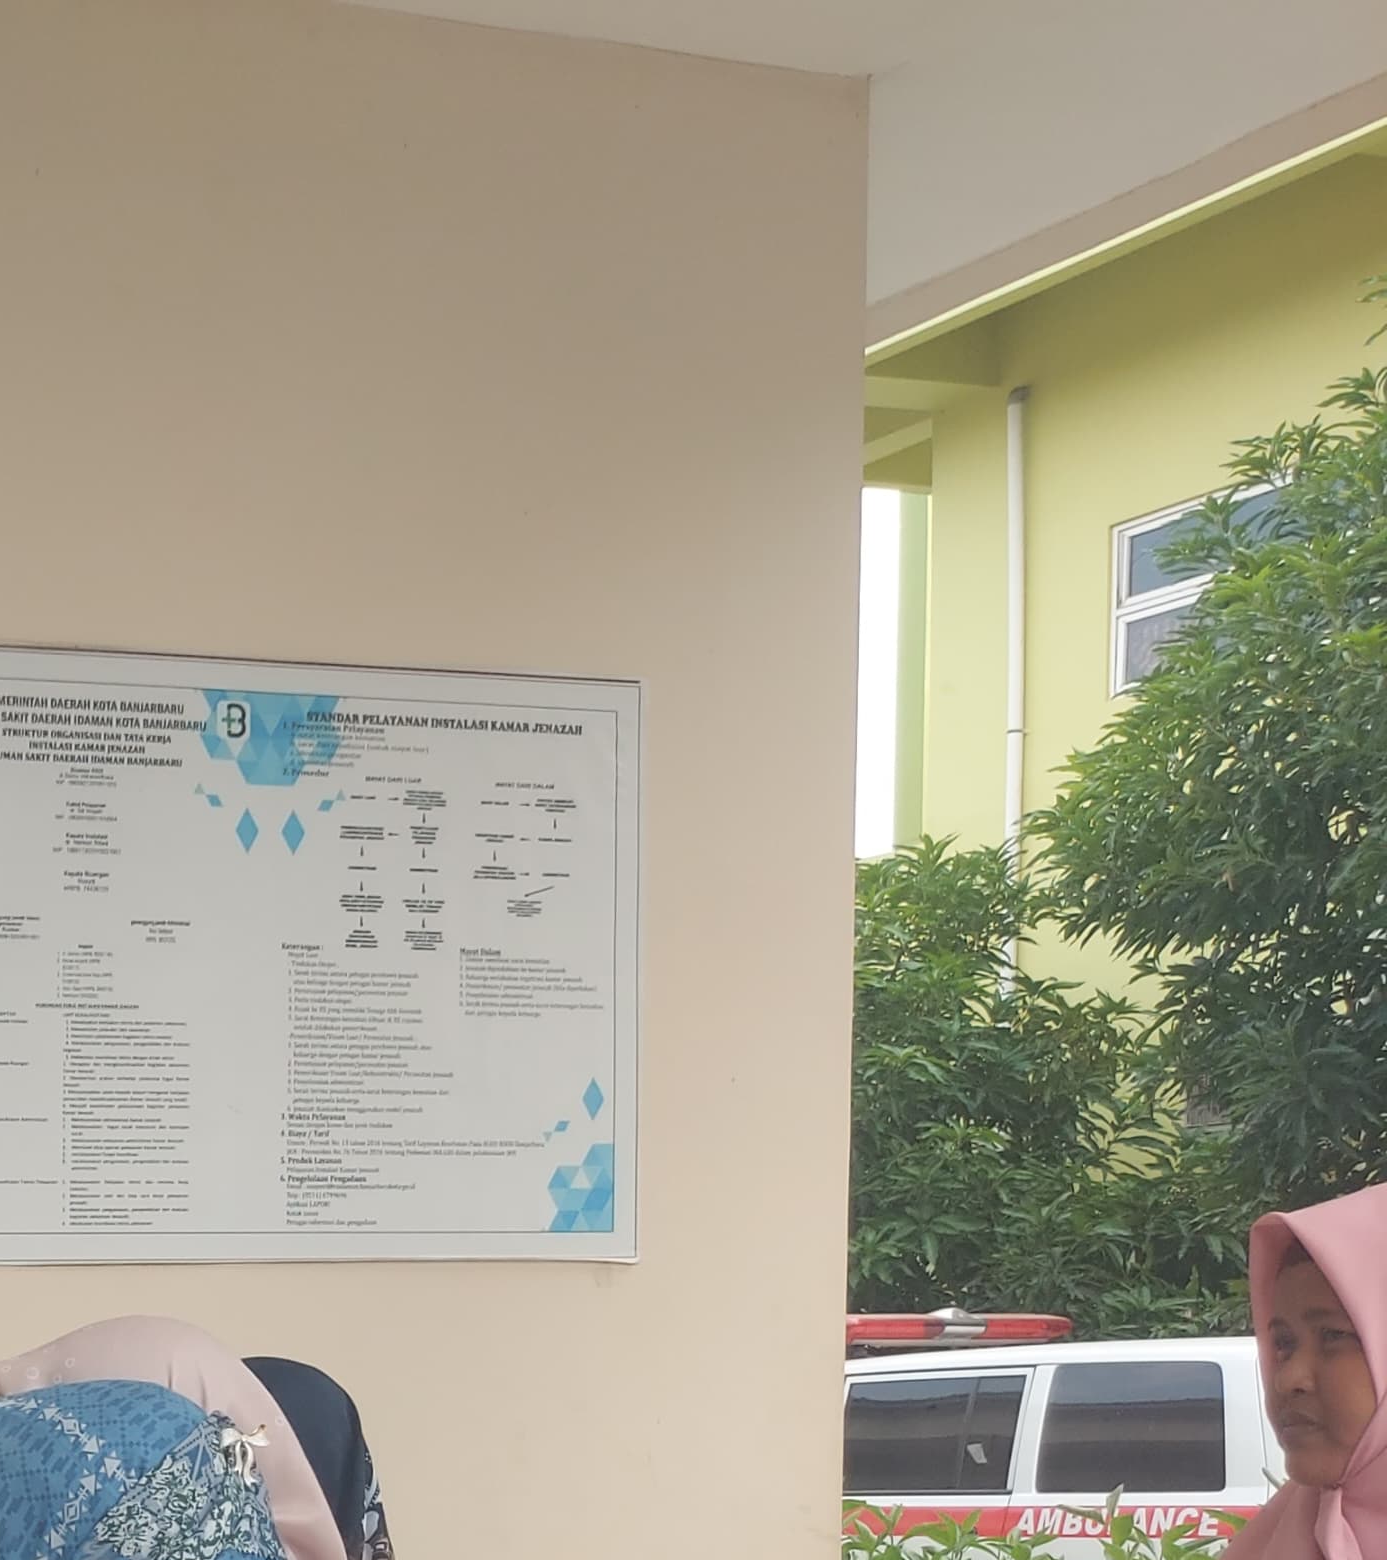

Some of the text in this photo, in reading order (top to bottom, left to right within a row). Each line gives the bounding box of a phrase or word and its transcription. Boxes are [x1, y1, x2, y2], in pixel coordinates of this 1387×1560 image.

[50, 697, 90, 711] DAERAH
[93, 700, 117, 712] KOTA
[119, 701, 184, 715] BANJARBARU
[1, 711, 28, 723] SAKIT
[31, 713, 71, 725] DAERAH
[74, 714, 113, 727] IDAMAN
[115, 716, 140, 729] KOTA
[142, 718, 207, 732] BANJARBARU
[306, 712, 583, 736] STANDAR PELAYANAN INSTALASI KAMAR JENAZAH
[2, 728, 171, 744] STRUKTUR ORGANISASI DAN TATA KERJA
[29, 741, 145, 755] INSTALASI KAMAR JENAZAH
[25, 752, 51, 762] SAKIT
[53, 753, 89, 764] DAERAH
[90, 755, 124, 766] IDAMAN
[126, 756, 183, 768] BANJARBARU
